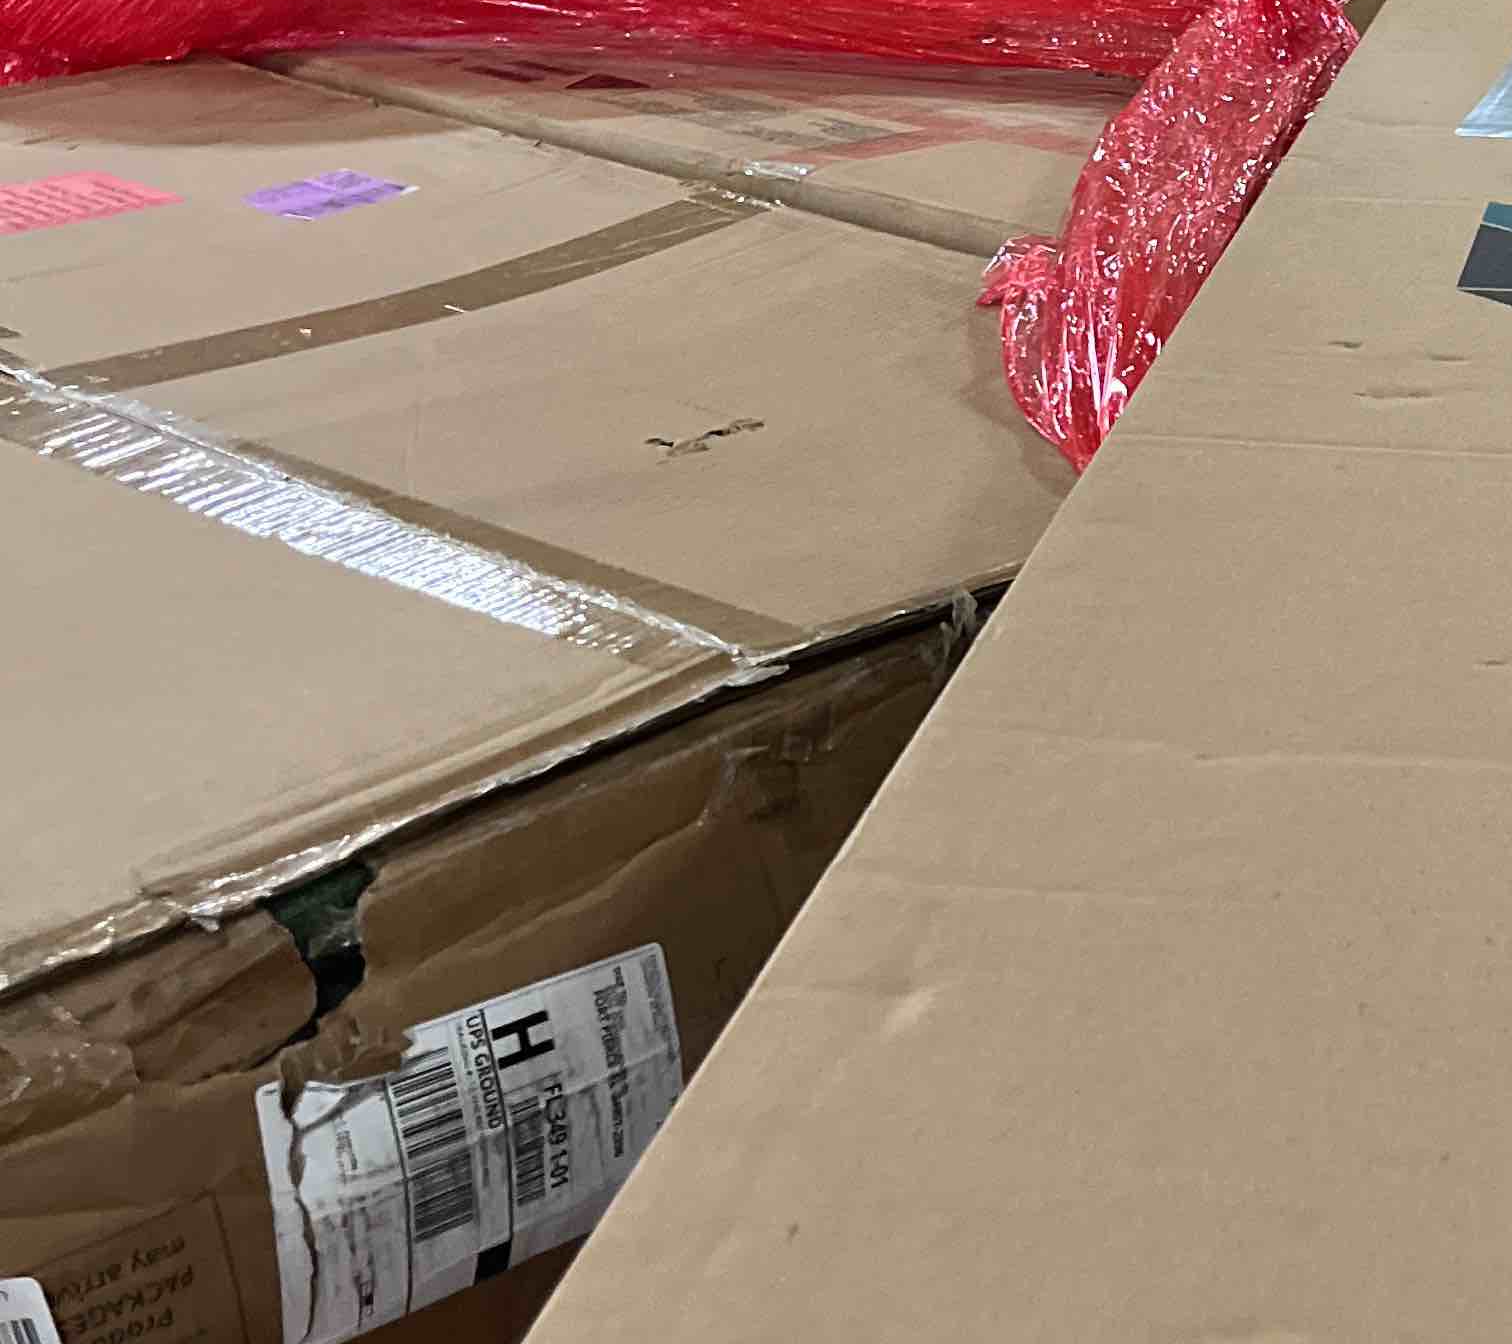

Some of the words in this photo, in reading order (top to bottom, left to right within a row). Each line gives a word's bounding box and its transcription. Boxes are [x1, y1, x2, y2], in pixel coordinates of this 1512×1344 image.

[491, 1010, 555, 1070] H
[465, 1015, 481, 1051] UPS
[474, 1052, 504, 1130] GROUND
[551, 1150, 569, 1189] 1-01
